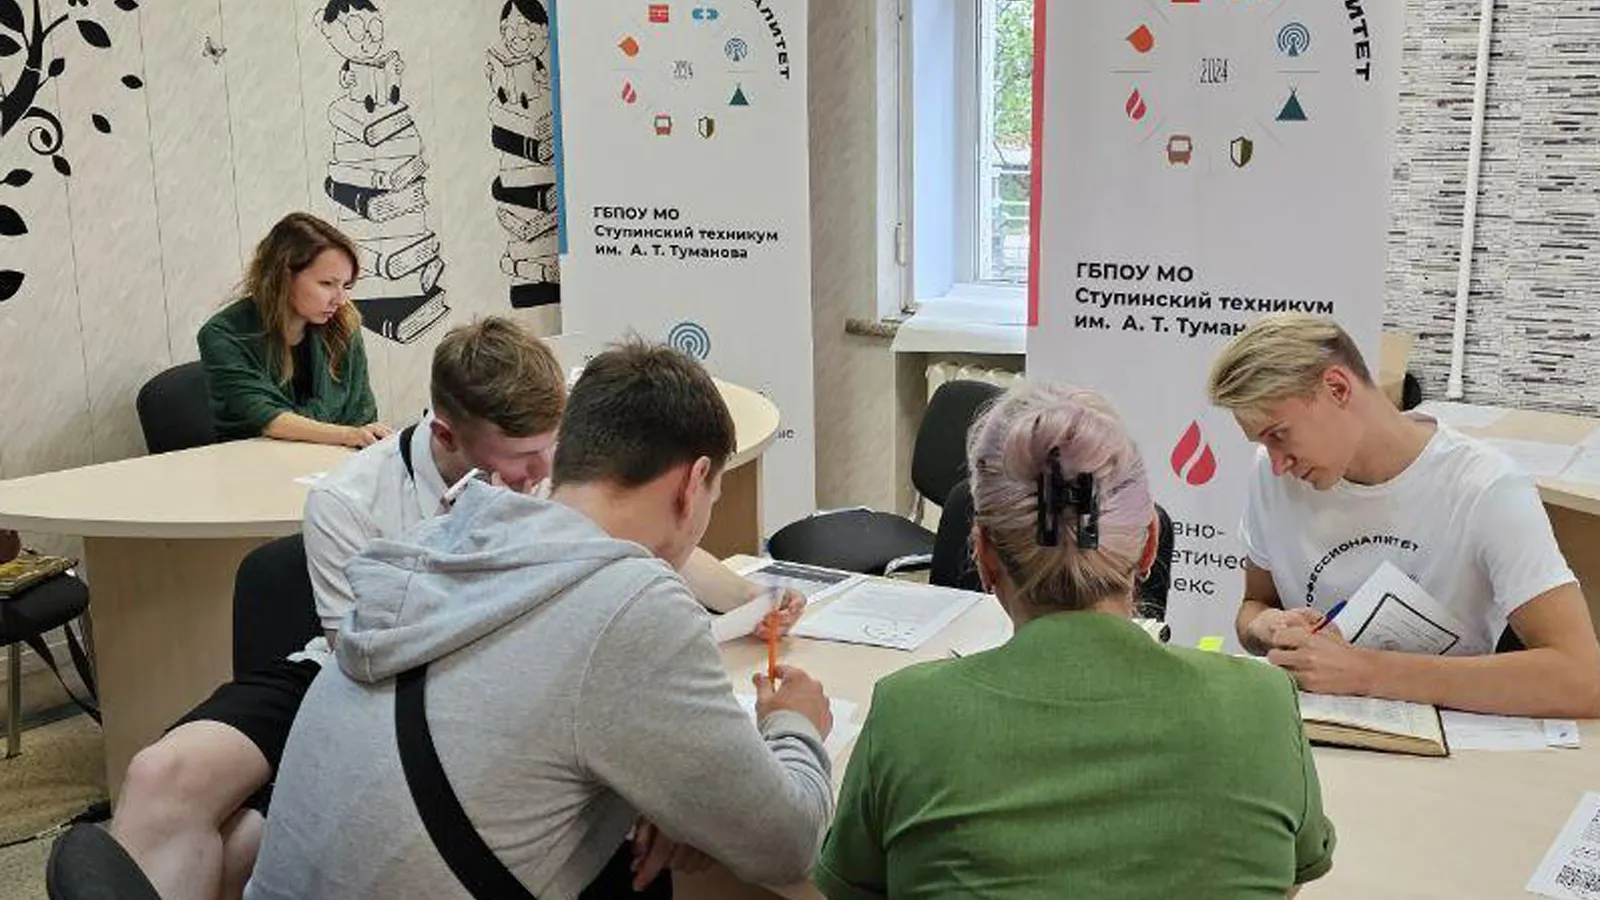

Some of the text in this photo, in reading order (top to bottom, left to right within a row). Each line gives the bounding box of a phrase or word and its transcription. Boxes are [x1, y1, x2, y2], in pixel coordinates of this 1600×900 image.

[1200, 58, 1228, 83] 2024
[593, 206, 679, 220] ГБПОУ МО
[594, 225, 778, 244] Ступинский техникум
[595, 244, 748, 260] им. А. Т. Туманова
[1076, 262, 1193, 282] ГБПОУ МО
[1075, 287, 1212, 309] Ступинский
[1074, 315, 1110, 330] им.
[1121, 314, 1144, 331] А.
[1151, 316, 1169, 332] Т.
[1305, 535, 1418, 607] ОФЕССИОНАЛИТЕТ
